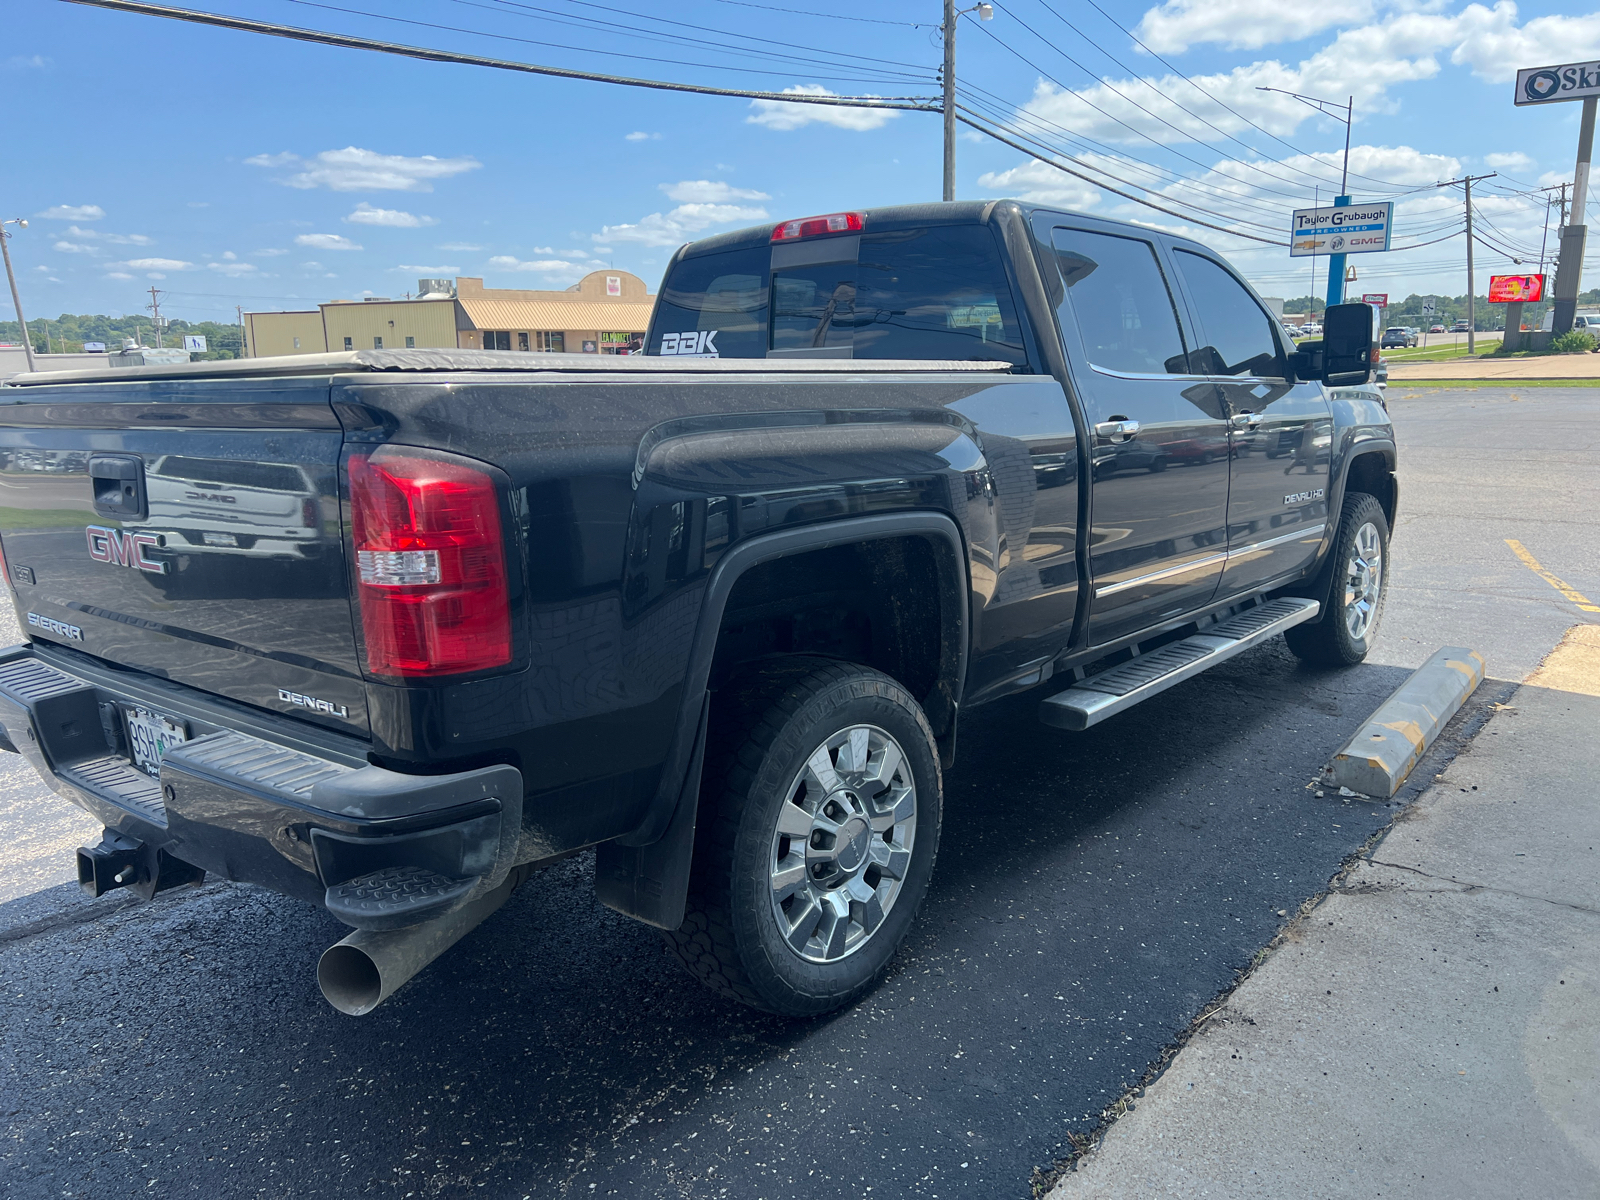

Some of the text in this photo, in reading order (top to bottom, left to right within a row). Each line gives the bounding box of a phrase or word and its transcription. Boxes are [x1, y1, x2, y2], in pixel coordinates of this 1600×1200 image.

[1297, 210, 1385, 228] Taylor Grubaugh
[1310, 226, 1368, 234] PRE-OWNED
[1350, 237, 1384, 245] GMC
[660, 330, 718, 355] BBK
[1283, 488, 1324, 504] DENALI HD
[86, 524, 170, 575] GMC
[27, 612, 84, 641] SIERRA
[278, 688, 349, 718] DENALI
